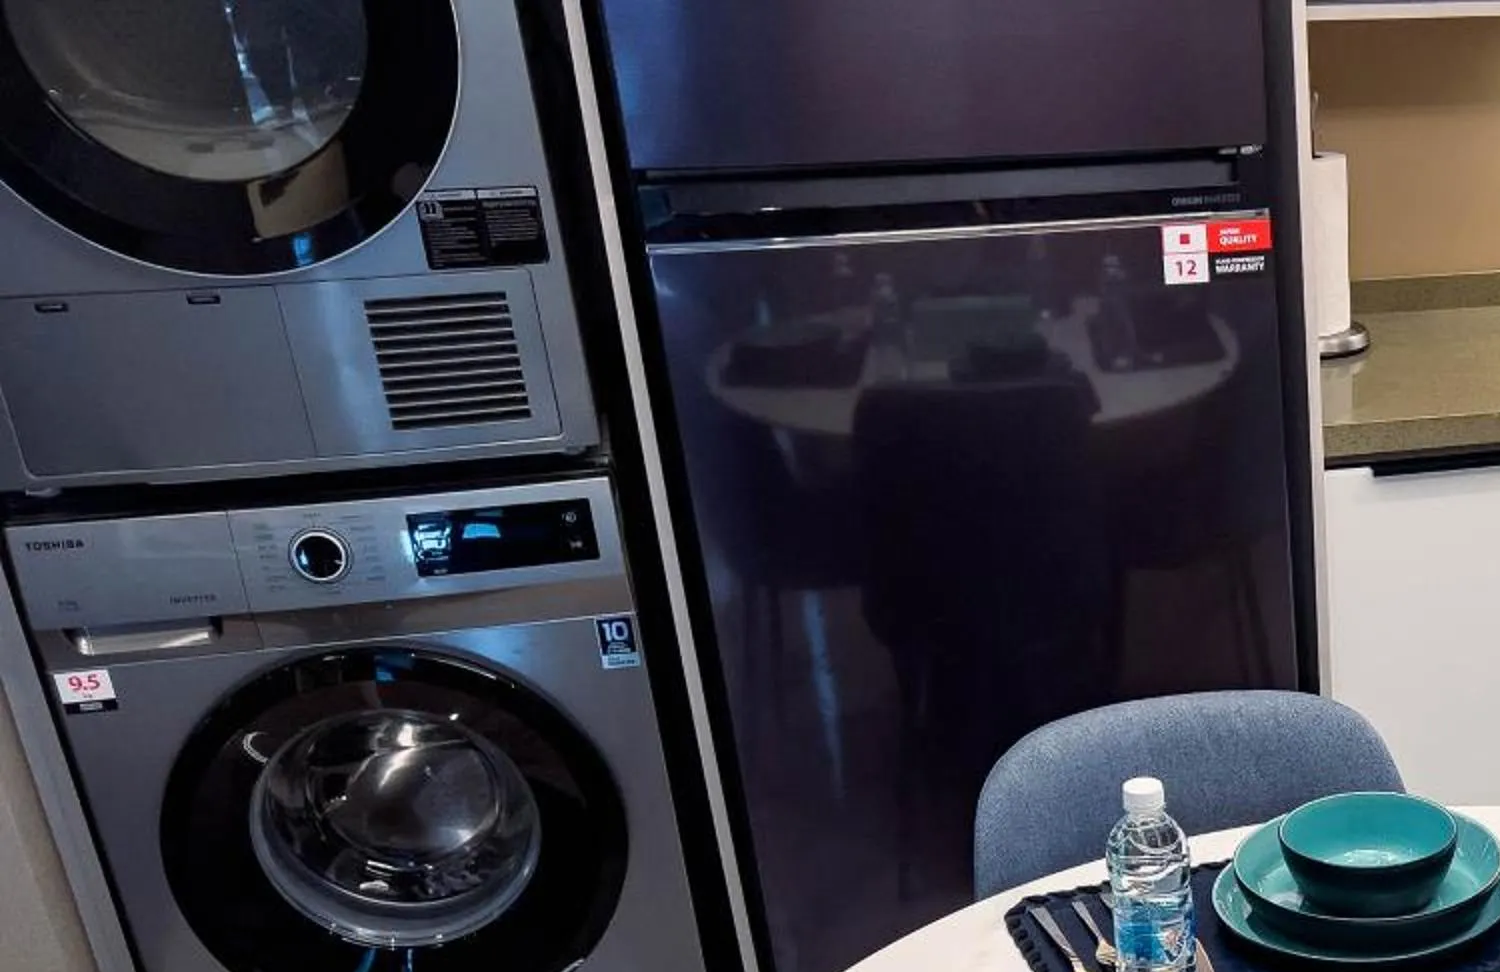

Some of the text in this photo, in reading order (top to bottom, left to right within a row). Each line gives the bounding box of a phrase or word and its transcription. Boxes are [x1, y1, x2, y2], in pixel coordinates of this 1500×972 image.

[1219, 233, 1258, 246] QUALITY
[1175, 259, 1197, 276] 12
[1215, 262, 1265, 274] WARRANTY
[25, 538, 85, 552] TOSHIBA
[602, 621, 629, 642] 10
[68, 673, 101, 691] 9.5
